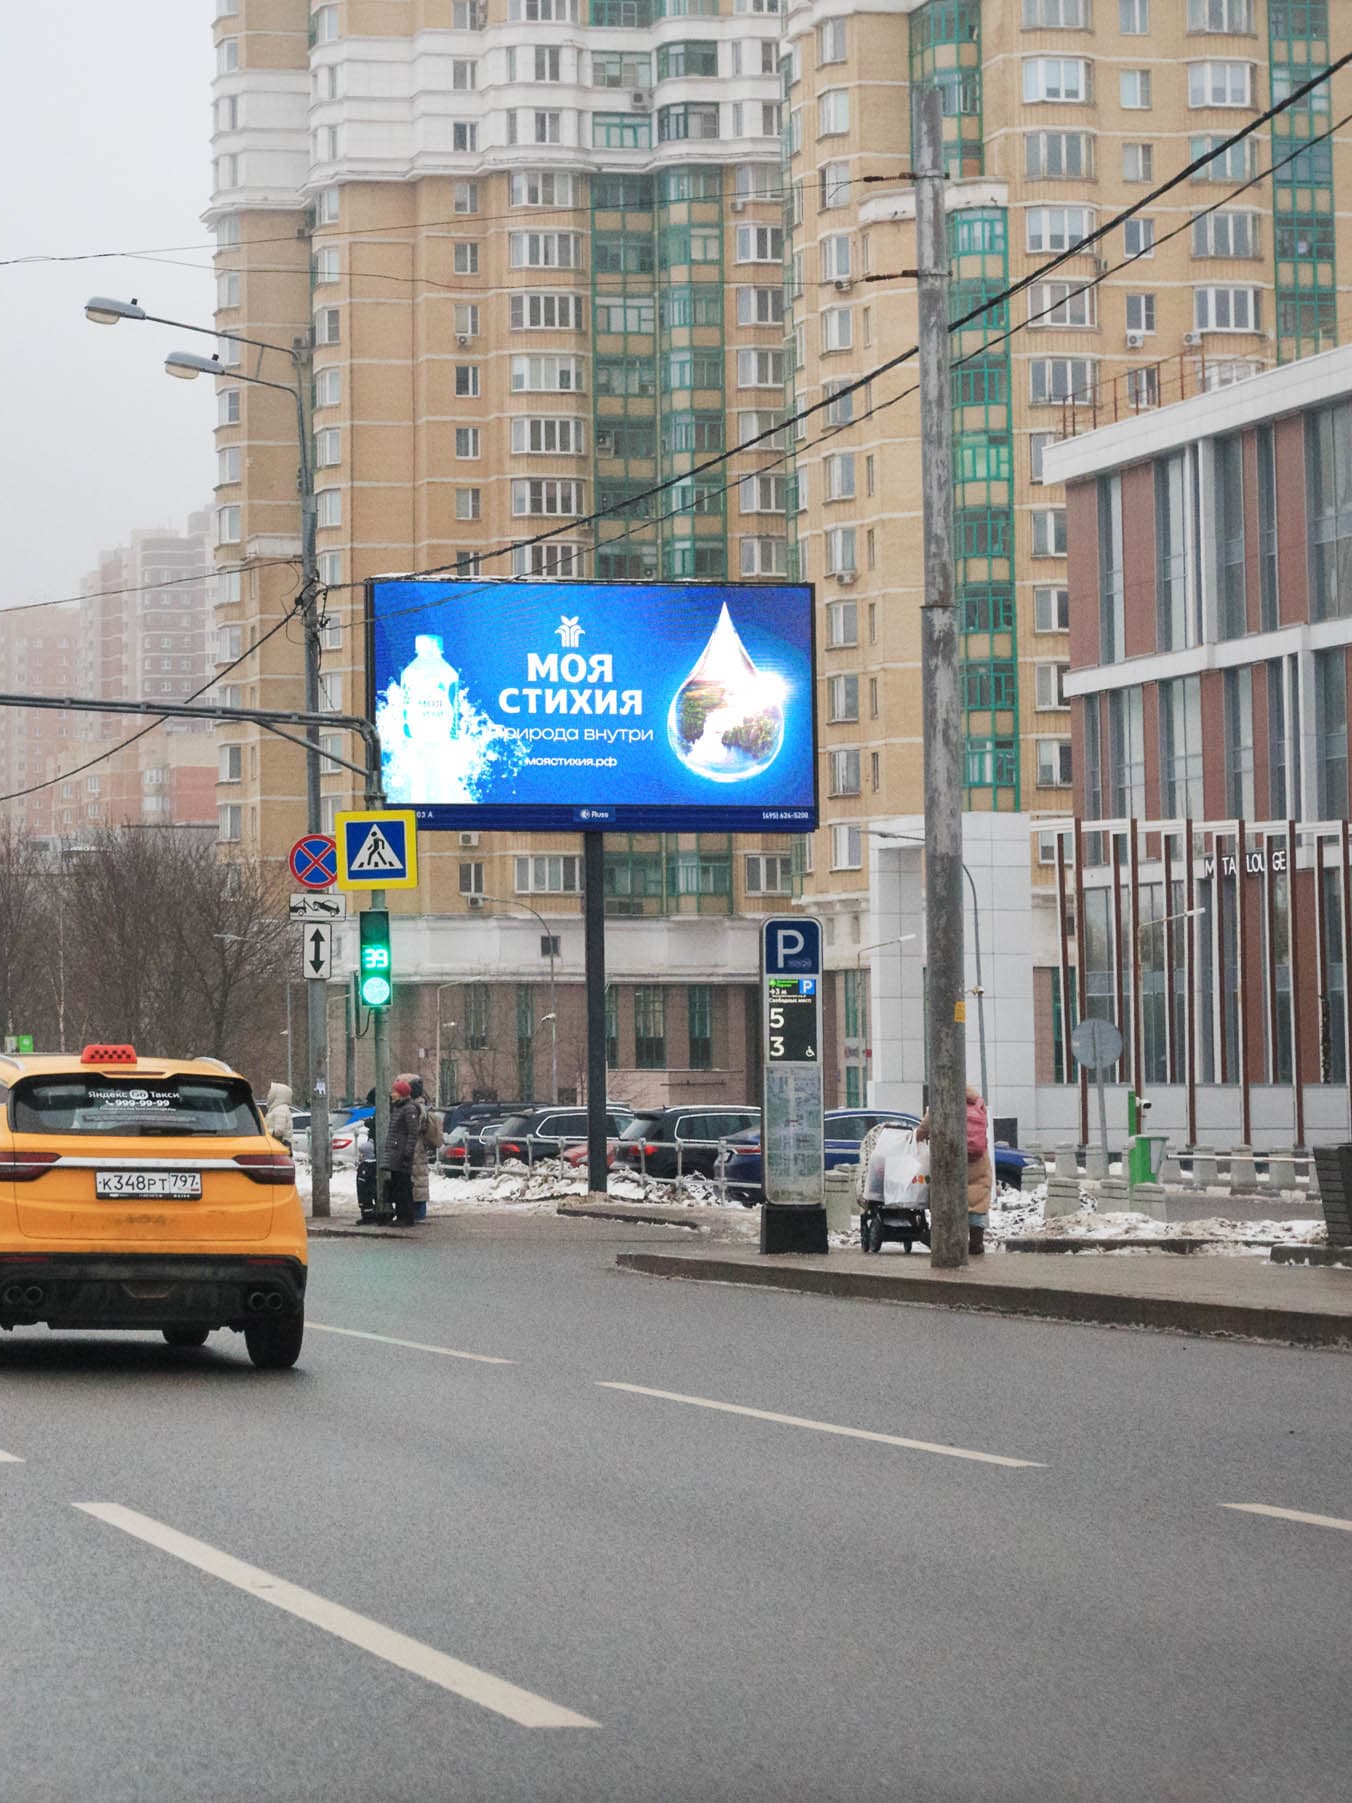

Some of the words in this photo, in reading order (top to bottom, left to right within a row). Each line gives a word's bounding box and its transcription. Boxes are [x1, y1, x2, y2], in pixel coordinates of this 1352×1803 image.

[527, 653, 614, 683] МОЯ
[498, 688, 643, 715] СТИХИЯ
[494, 726, 579, 742] рирода
[583, 727, 654, 744] внутри
[524, 756, 618, 768] моястихия.рф
[1205, 856, 1237, 878] MTA
[1245, 850, 1287, 873] LOUGE
[365, 948, 389, 968] 39
[777, 929, 805, 969] P
[769, 1007, 785, 1029] 5
[769, 1036, 785, 1057] 3
[88, 1090, 128, 1099] Яндекс
[149, 1090, 181, 1099] Такси
